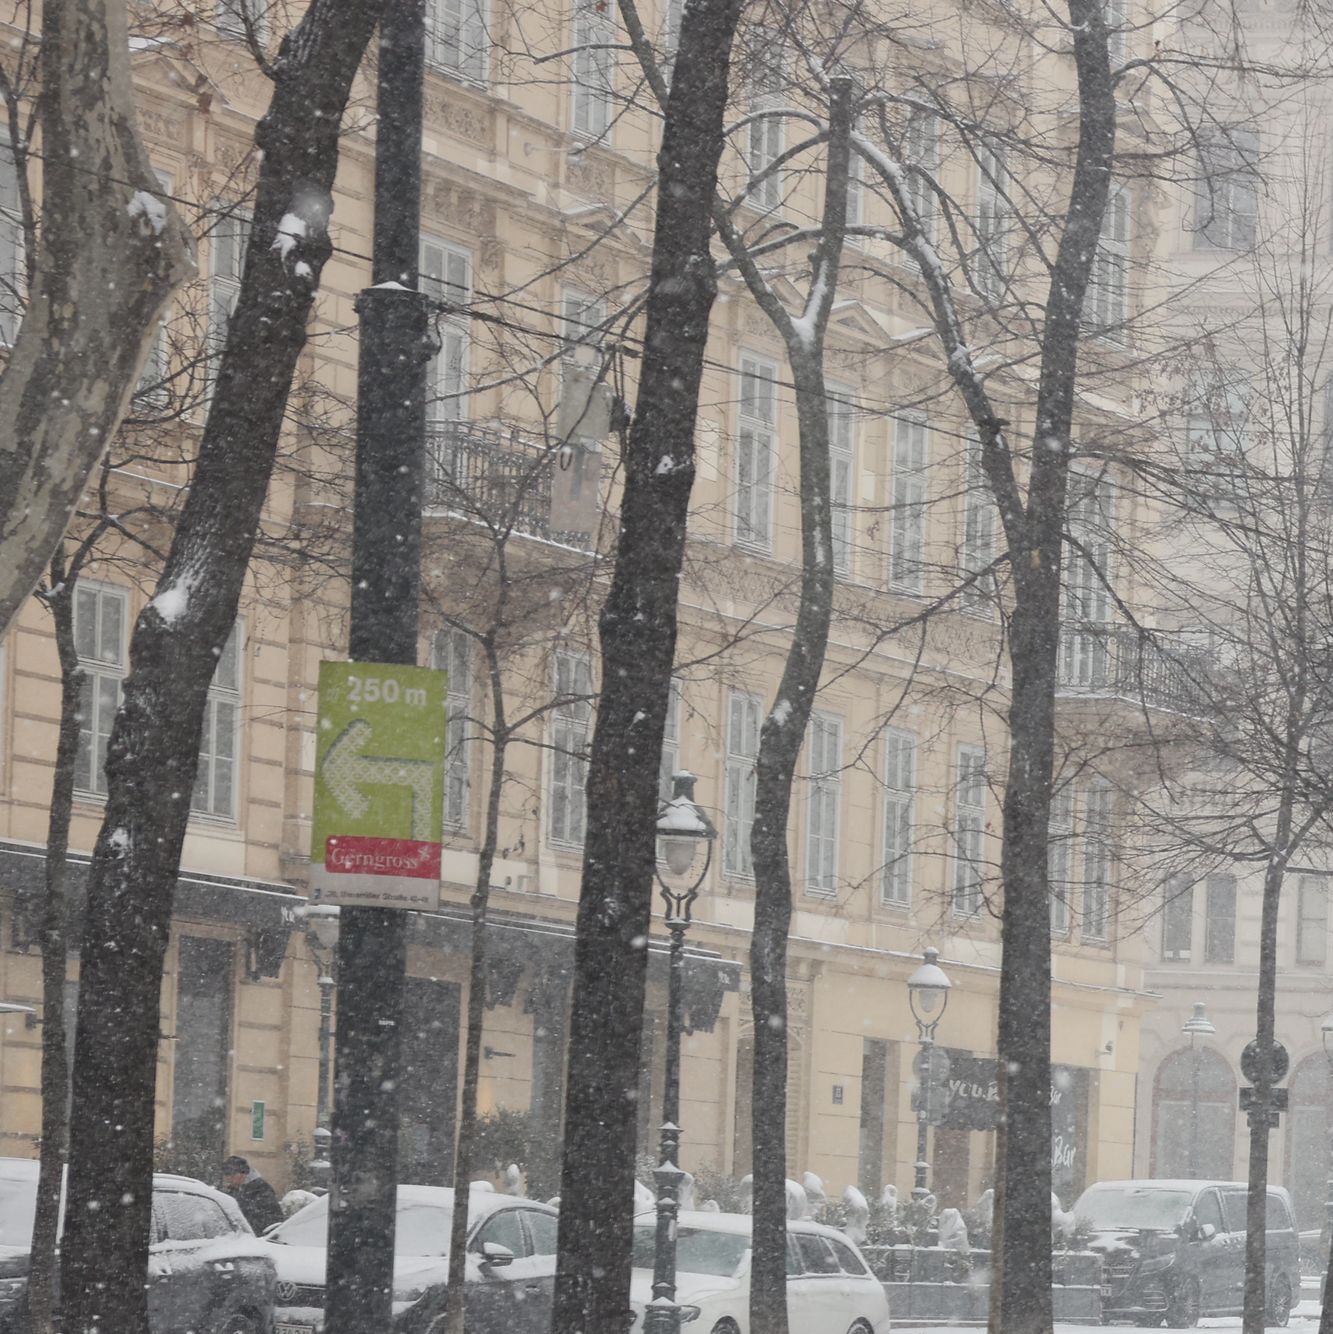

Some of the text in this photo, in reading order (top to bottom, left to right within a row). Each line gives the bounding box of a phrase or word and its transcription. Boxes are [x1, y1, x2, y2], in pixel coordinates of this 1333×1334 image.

[347, 677, 427, 705] 250 m
[331, 847, 418, 870] Gerngross
